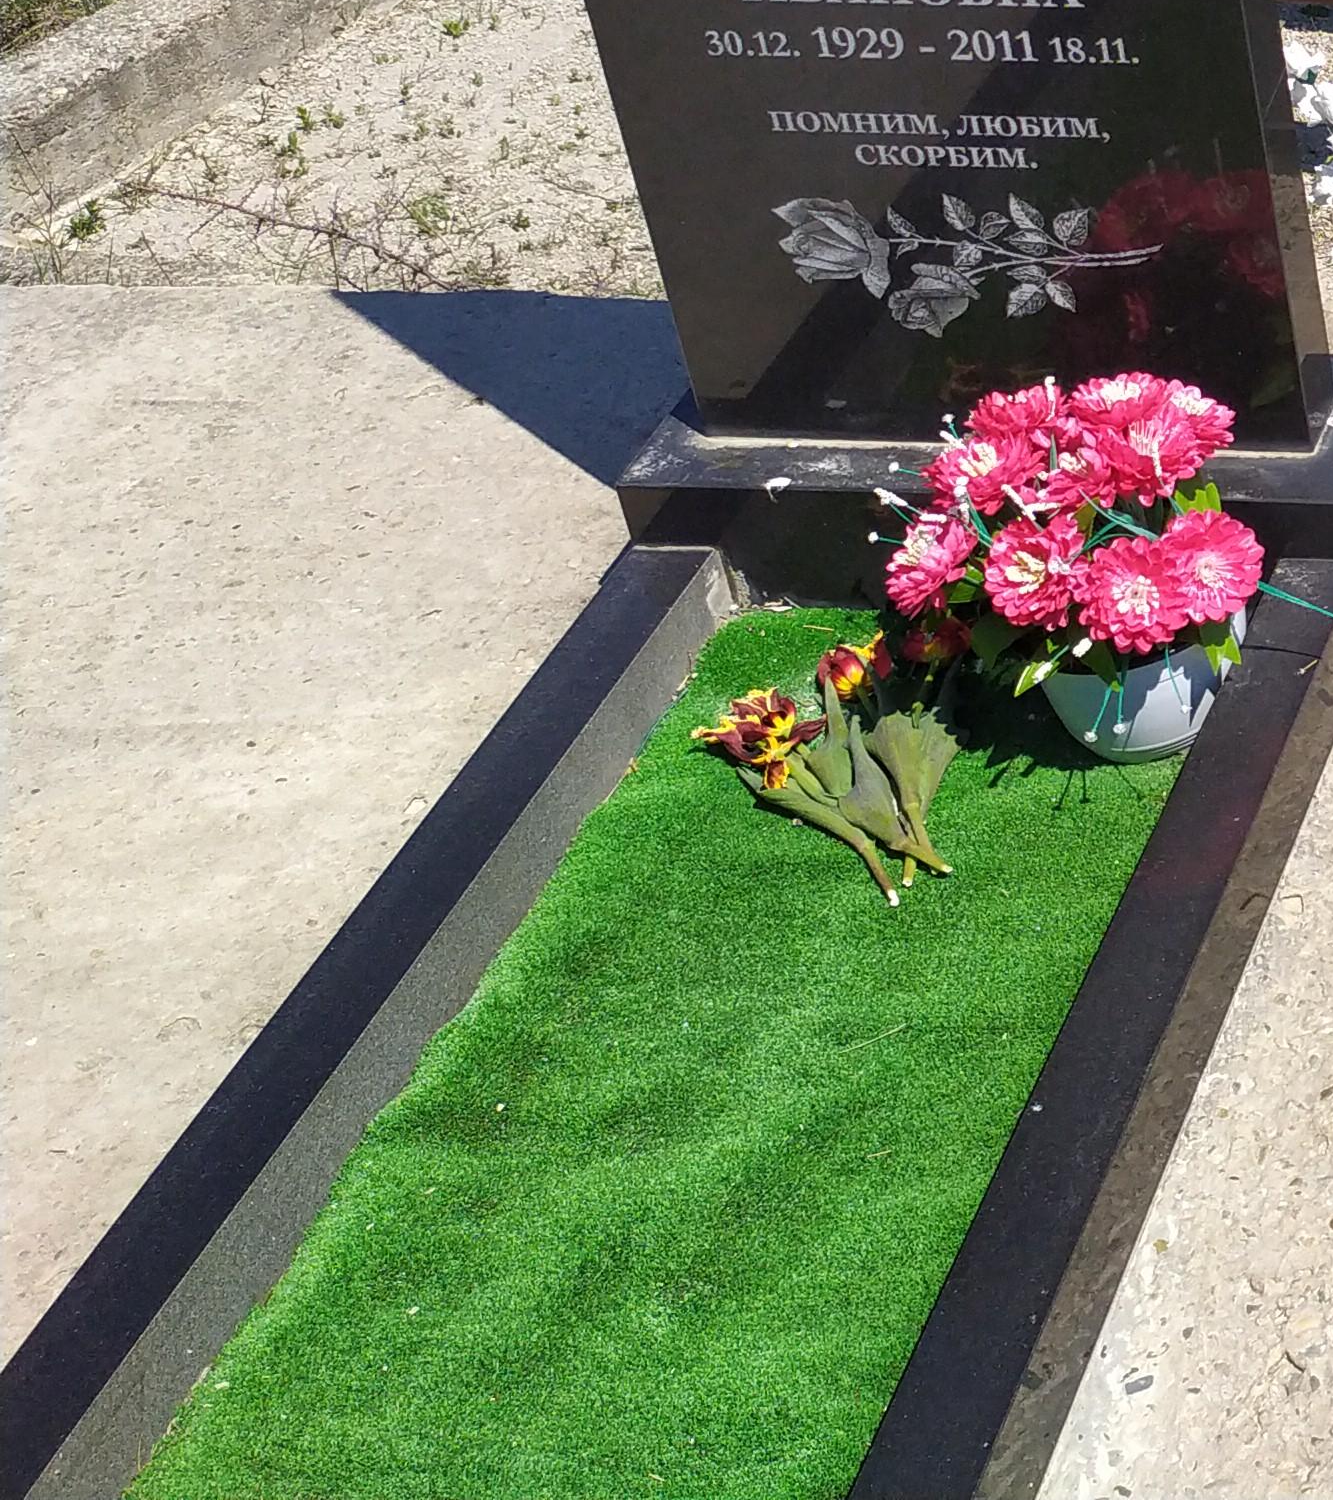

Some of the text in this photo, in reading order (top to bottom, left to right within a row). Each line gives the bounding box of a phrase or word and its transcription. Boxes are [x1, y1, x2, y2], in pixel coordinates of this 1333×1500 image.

[704, 29, 801, 58] 30.12.
[811, 26, 904, 60] 1929
[947, 29, 1040, 63] 2011
[1049, 36, 1140, 65] 18.11.
[768, 110, 1111, 144] ПОМНИМ, ЛЮБИМ,
[855, 143, 1039, 170] СКОРБИМ.
